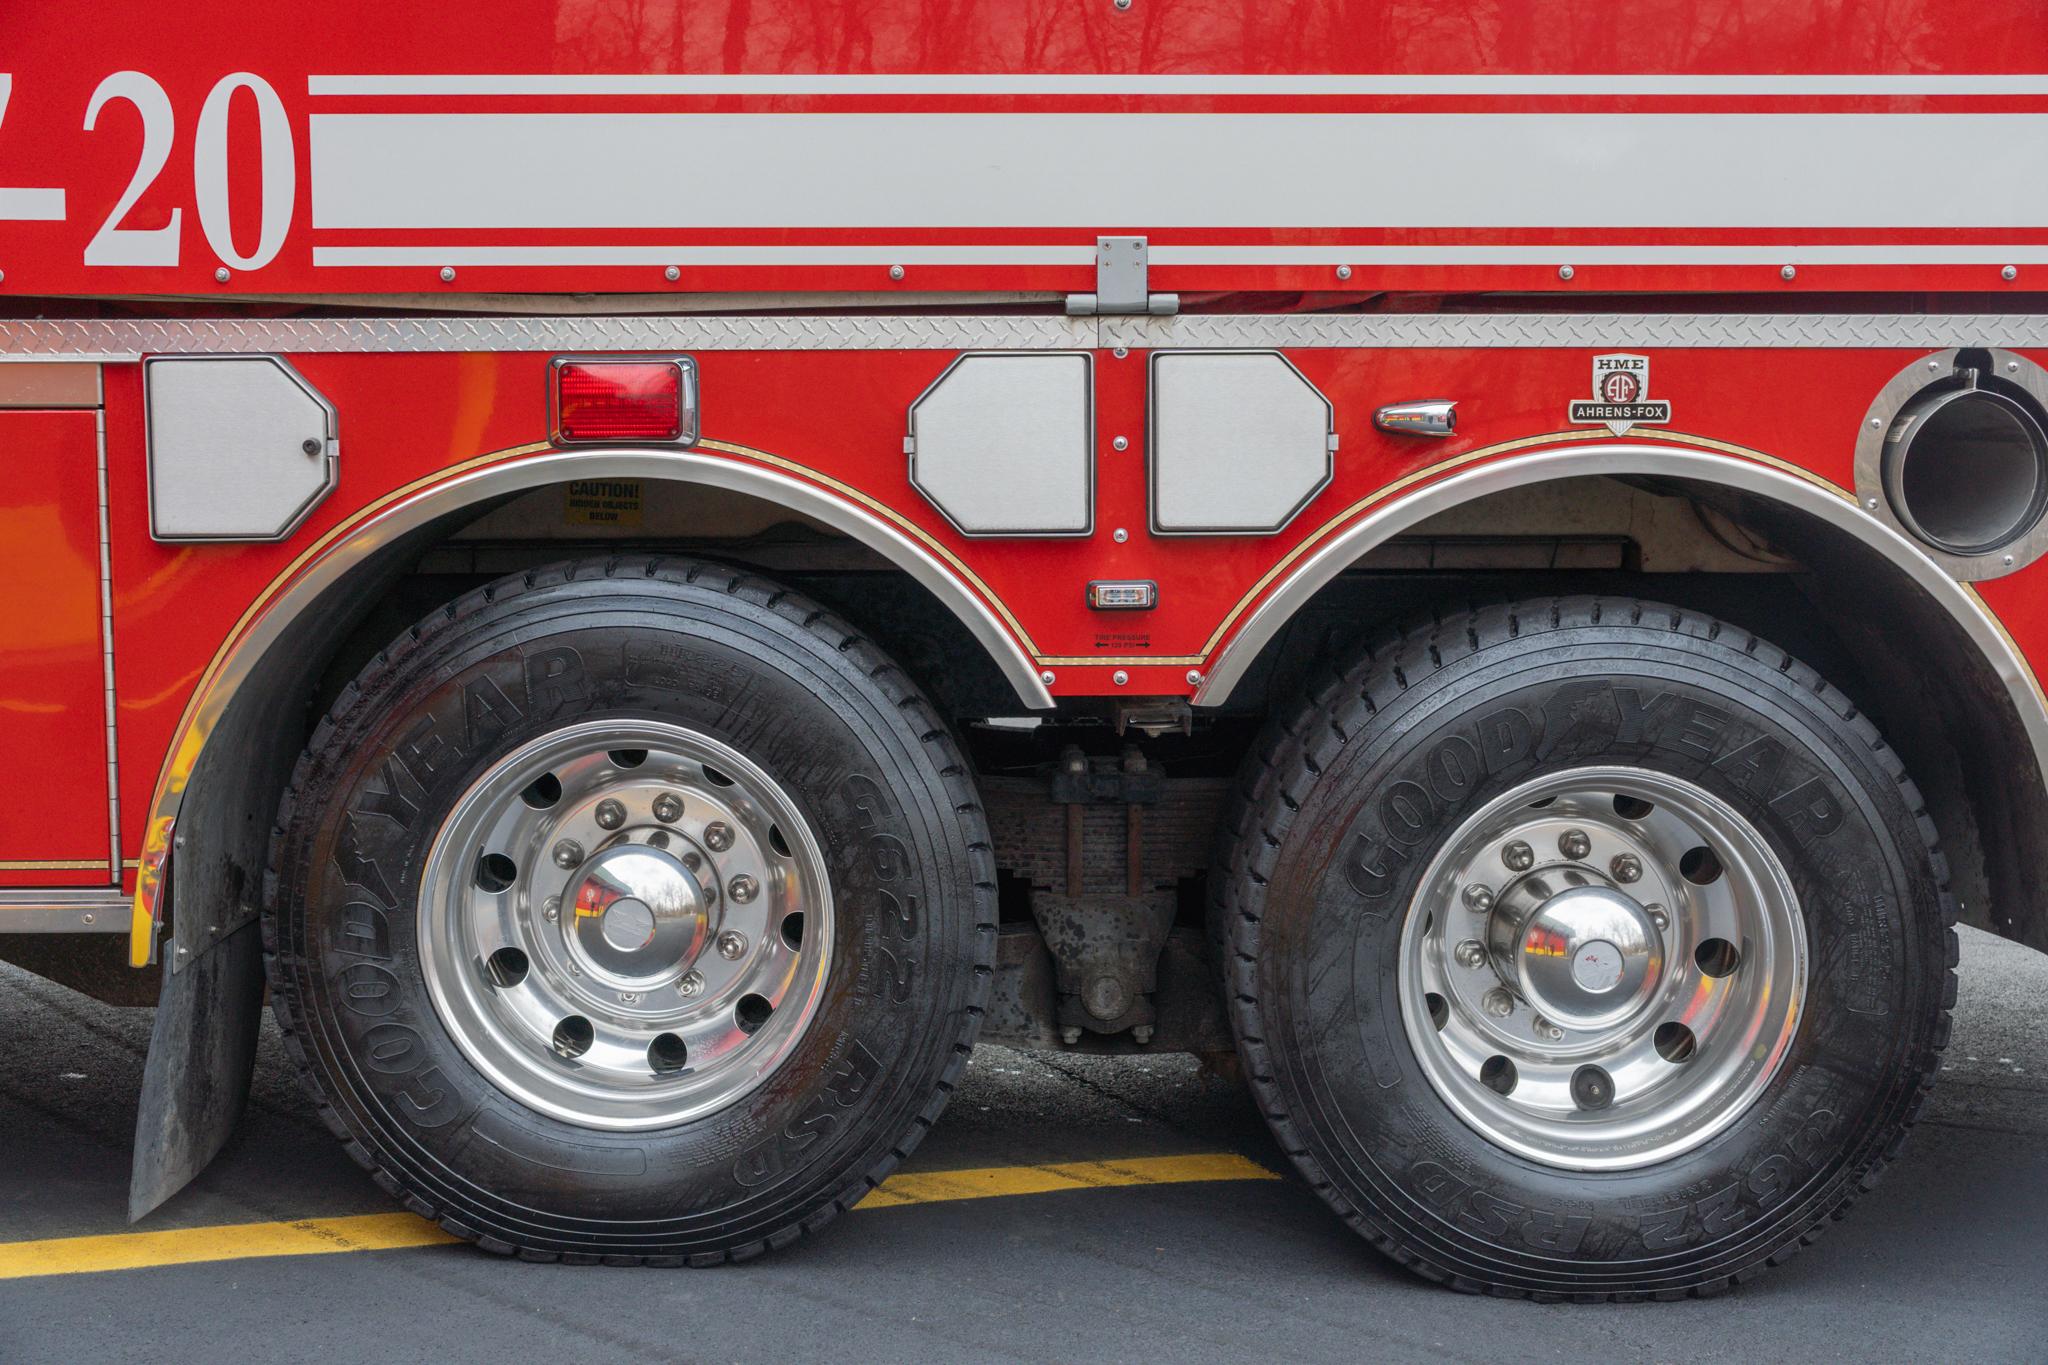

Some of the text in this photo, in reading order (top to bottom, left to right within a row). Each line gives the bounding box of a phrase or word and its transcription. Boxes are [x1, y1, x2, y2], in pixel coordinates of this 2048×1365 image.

[0, 70, 296, 271] -20
[1577, 406, 1664, 418] AHRENS-FOX
[1598, 359, 1645, 370] HME
[569, 482, 640, 498] CAUTION!
[588, 511, 619, 521] BELOW
[1344, 684, 1847, 899] GOODYEAR
[332, 645, 589, 1128] GOODYEAR
[840, 773, 920, 1005] G622
[732, 1038, 884, 1188] RSD
[1639, 1108, 1838, 1251] G622
[1409, 1160, 1592, 1254] RSD
